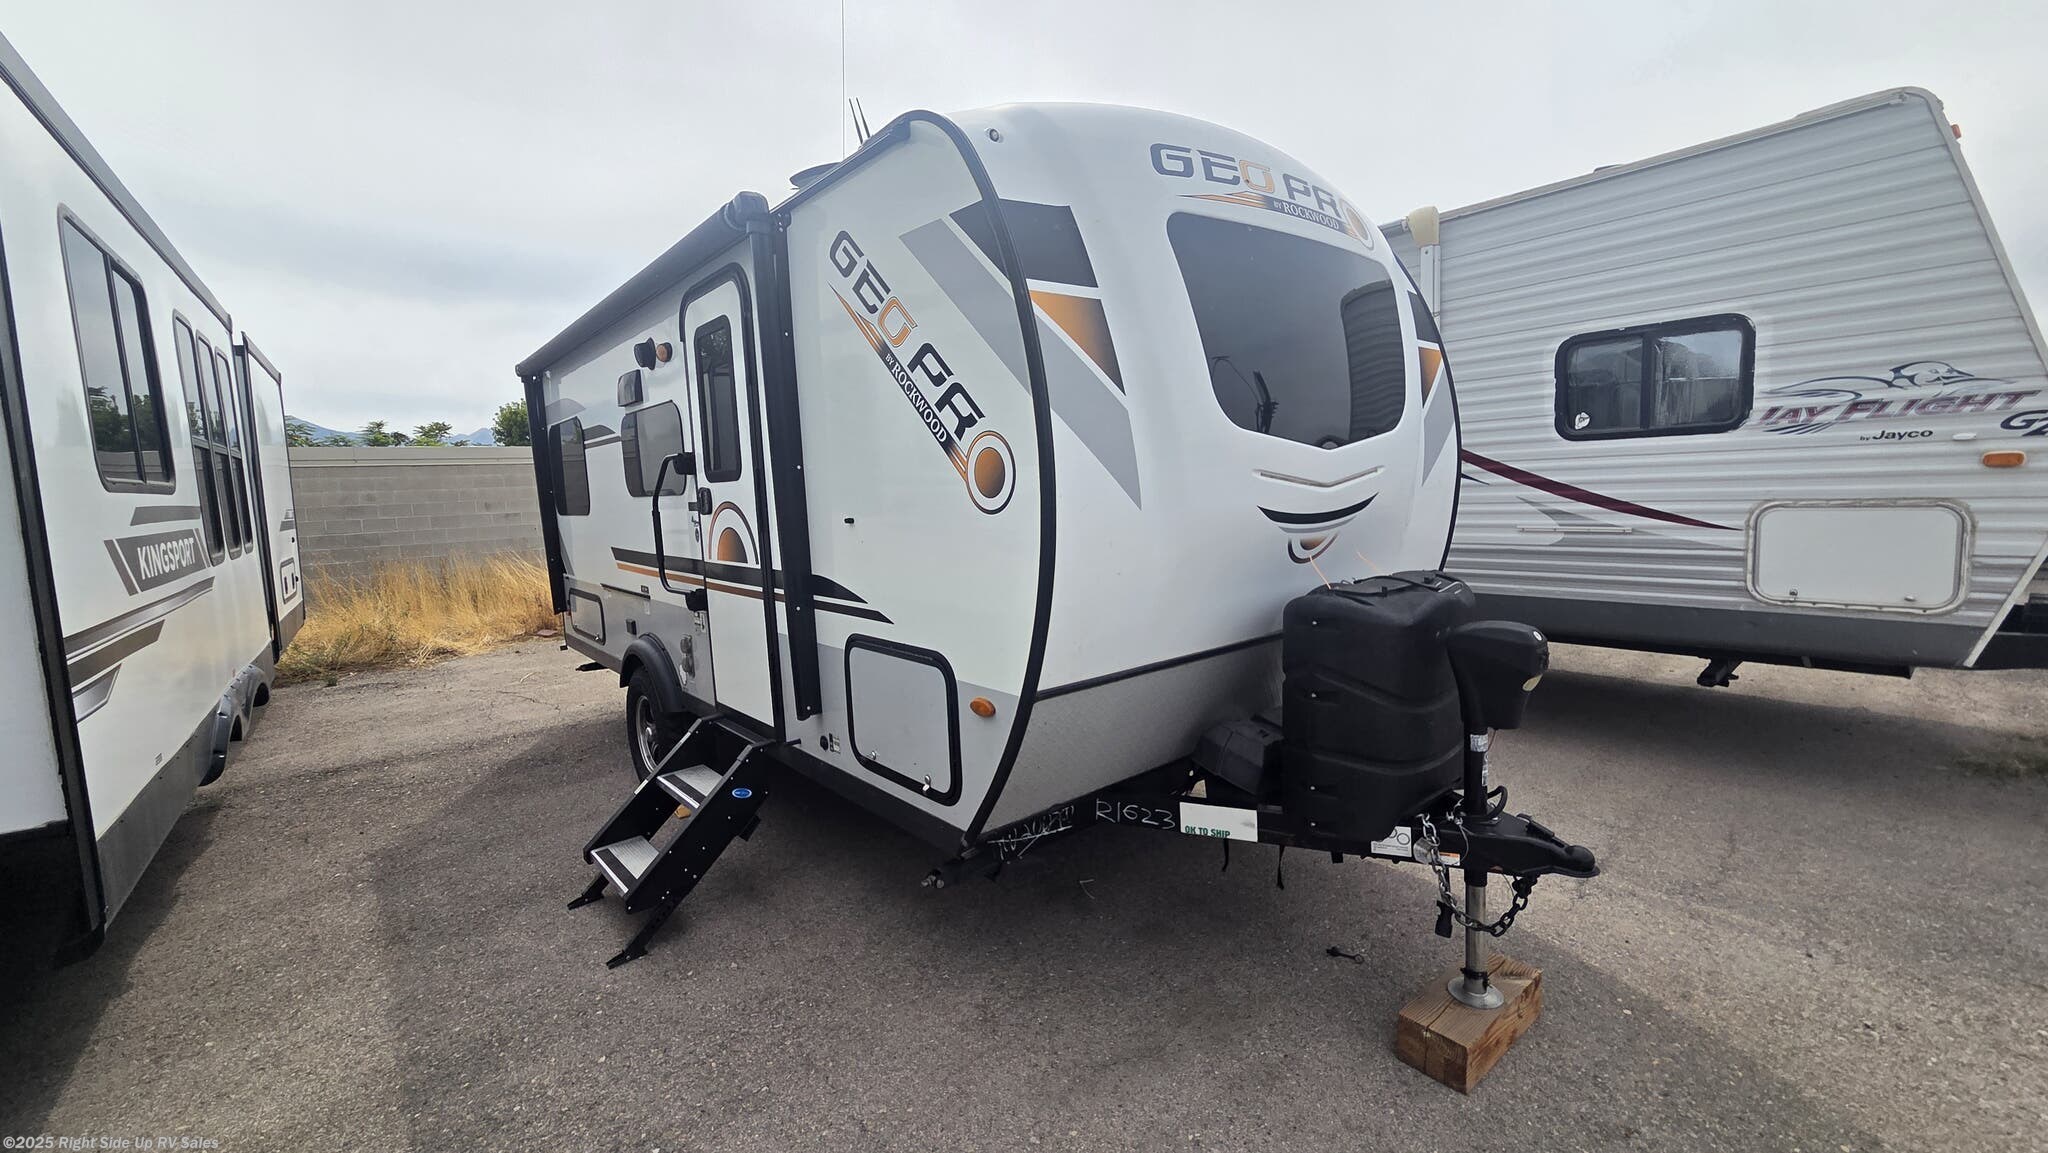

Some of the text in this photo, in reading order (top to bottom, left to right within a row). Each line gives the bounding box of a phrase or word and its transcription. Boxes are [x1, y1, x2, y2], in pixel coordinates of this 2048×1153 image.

[1150, 143, 1276, 193] GEO
[1282, 201, 1340, 231] ROCKWOOD
[829, 230, 918, 348] GEO
[885, 353, 948, 443] BY ROCKWOOD
[1759, 390, 2042, 426] JAY FLIGHT
[1873, 429, 1934, 442] Jayco
[137, 537, 196, 580] KINGSPORT
[1095, 798, 1176, 830] R1623
[1184, 825, 1231, 839] OK TO SHIP
